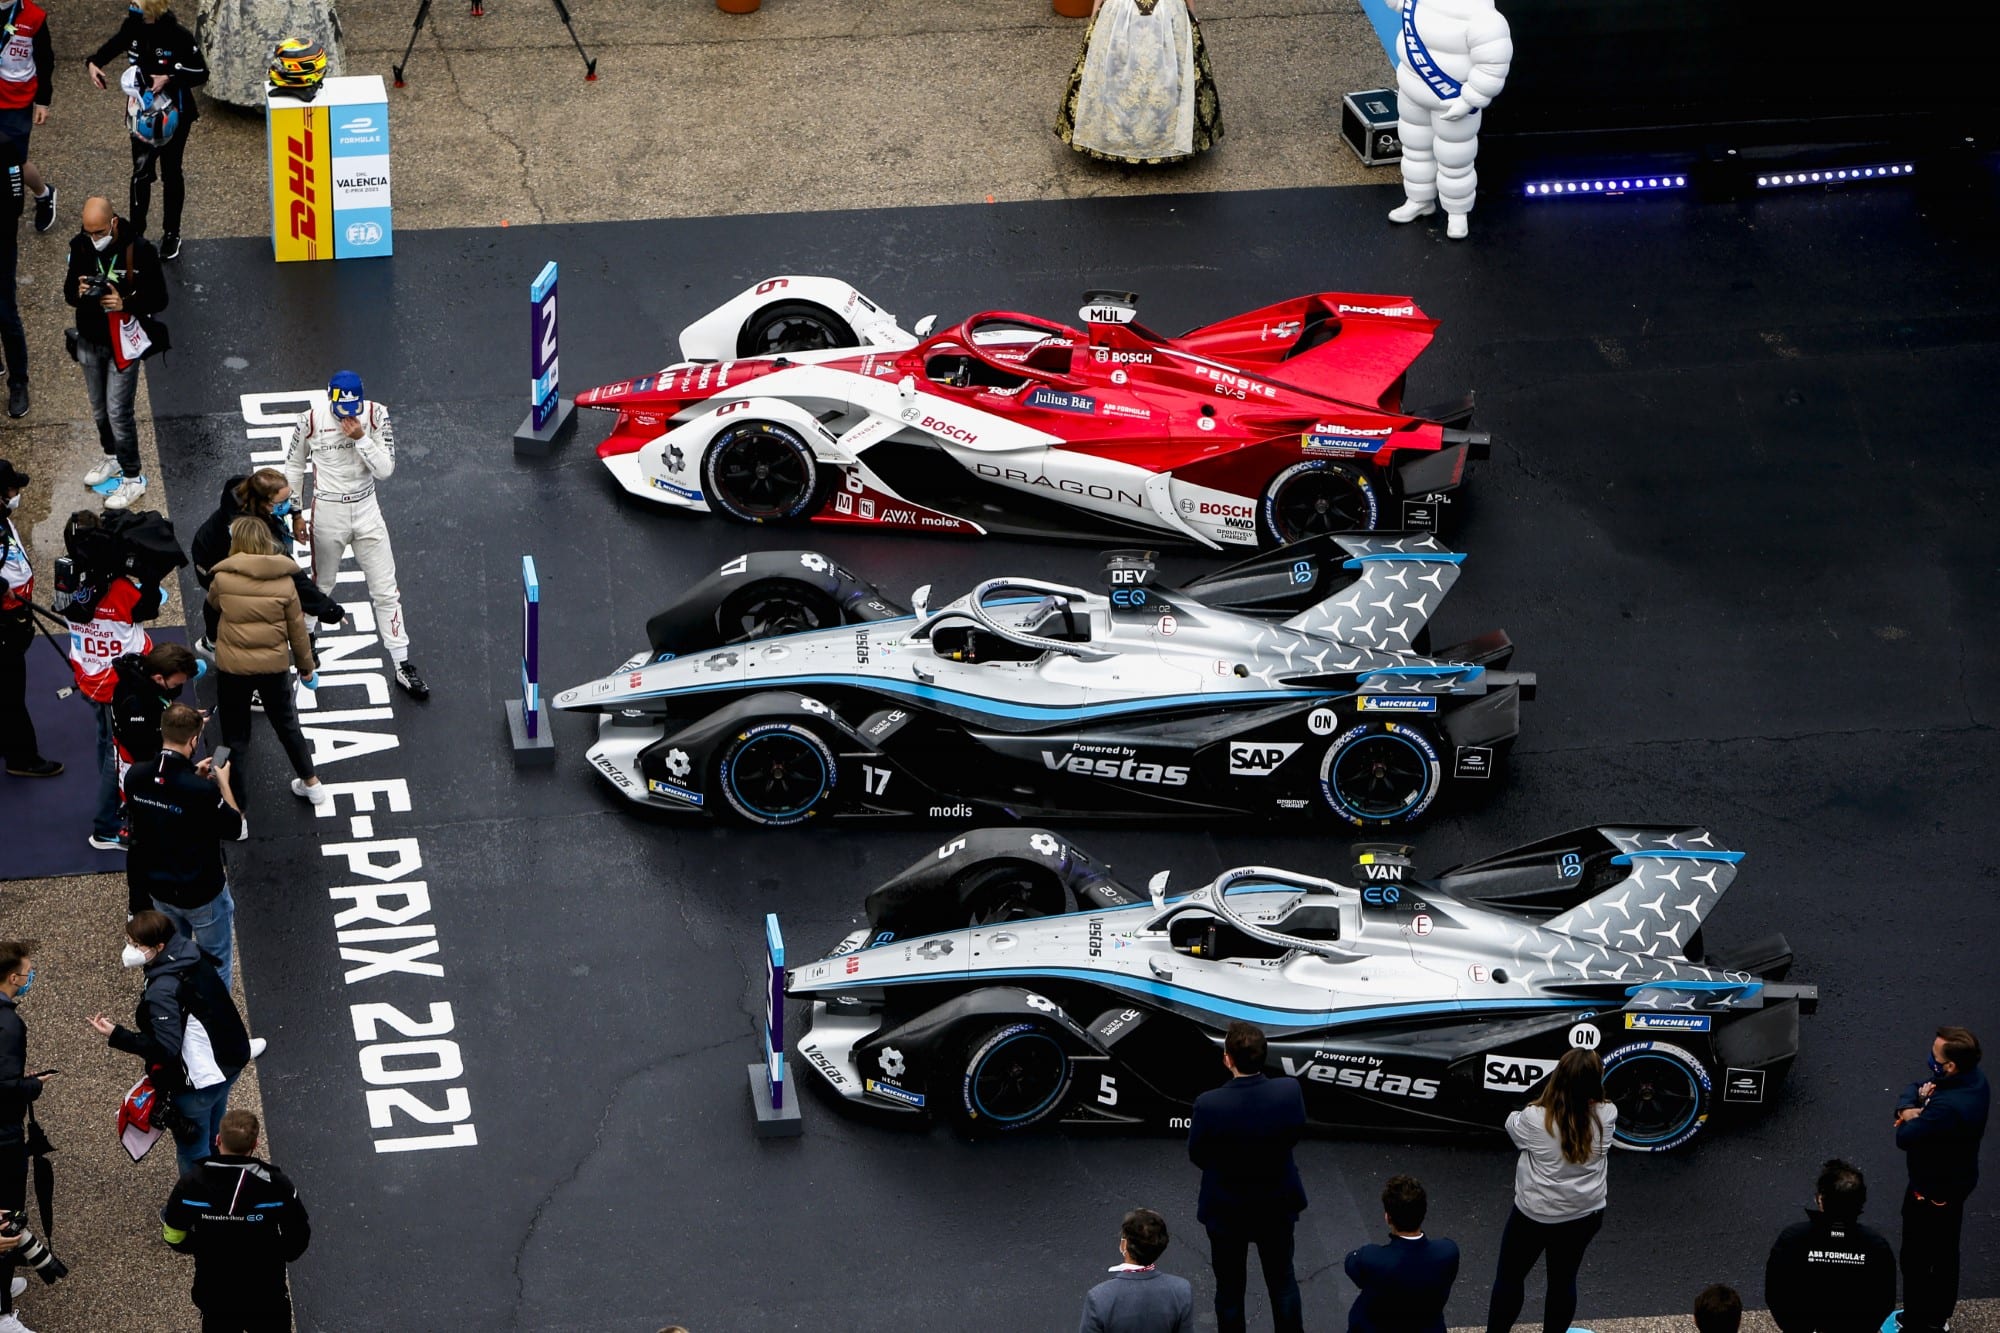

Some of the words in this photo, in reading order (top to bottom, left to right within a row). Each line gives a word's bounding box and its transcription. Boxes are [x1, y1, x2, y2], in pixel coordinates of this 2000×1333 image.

[9, 47, 29, 58] 045
[340, 136, 375, 144] FORMULA
[375, 135, 381, 143] E
[288, 129, 317, 241] DHL
[336, 177, 388, 188] VALENCIA
[348, 226, 378, 241] FIA
[1090, 306, 1123, 323] MÜL
[1338, 305, 1413, 317] billboard
[541, 295, 556, 366] 2
[1111, 352, 1152, 364] BOSCH
[1195, 366, 1277, 398] PENSKE
[1035, 392, 1068, 406] Julius
[1071, 396, 1093, 410] Bär
[1214, 384, 1247, 401] EV-5
[846, 421, 882, 443] PENSKE
[920, 416, 978, 445] BOSCH
[1200, 419, 1212, 430] E
[1315, 424, 1393, 436] billboard
[775, 429, 804, 450] MICHELIN
[1322, 439, 1369, 448] MICHELIN
[846, 466, 863, 494] 6
[976, 464, 1143, 507] DRAGON
[663, 484, 693, 498] MICHELIN
[880, 509, 916, 525] AVX
[1200, 503, 1253, 518] BOSCH
[921, 516, 960, 528] molex
[1265, 499, 1282, 540] MICHELIN
[1112, 570, 1148, 584] DEV
[1293, 561, 1312, 583] EQ
[1112, 589, 1146, 606] EQ
[1162, 617, 1173, 633] E
[84, 637, 122, 657] 059
[855, 629, 870, 664] Vestas
[1217, 660, 1227, 676] E
[1379, 701, 1430, 709] MICHELIN
[752, 724, 789, 733] MICHELIN
[1314, 716, 1332, 729] ON
[1072, 743, 1121, 755] Powered
[1123, 746, 1137, 756] by
[1401, 728, 1436, 760] MICHELIN
[1231, 748, 1285, 770] SAP
[592, 753, 635, 788] Vestas
[1041, 750, 1191, 786] Vestas
[862, 764, 892, 796] 17
[664, 787, 698, 801] MICHELIN
[929, 803, 973, 817] modis
[938, 838, 966, 859] 5
[1365, 866, 1402, 880] VAN
[1562, 853, 1582, 877] EQ
[315, 779, 445, 985] E-PRIX
[1364, 887, 1401, 903] EQ
[1417, 916, 1428, 934] E
[1089, 917, 1104, 957] Vestas
[1474, 966, 1484, 981] E
[1649, 1018, 1703, 1027] MICHELIN
[1575, 1031, 1594, 1045] ON
[1315, 1050, 1365, 1063] Powered
[1368, 1056, 1383, 1067] by
[1603, 1042, 1648, 1067] MICHELIN
[804, 1044, 848, 1085] Vestas
[350, 1001, 478, 1153] 2021
[1280, 1057, 1441, 1100] Vestas
[1486, 1062, 1544, 1086] SAP
[883, 1087, 919, 1102] MICHELIN
[1097, 1074, 1118, 1106] 5
[1808, 1250, 1823, 1258] ABB
